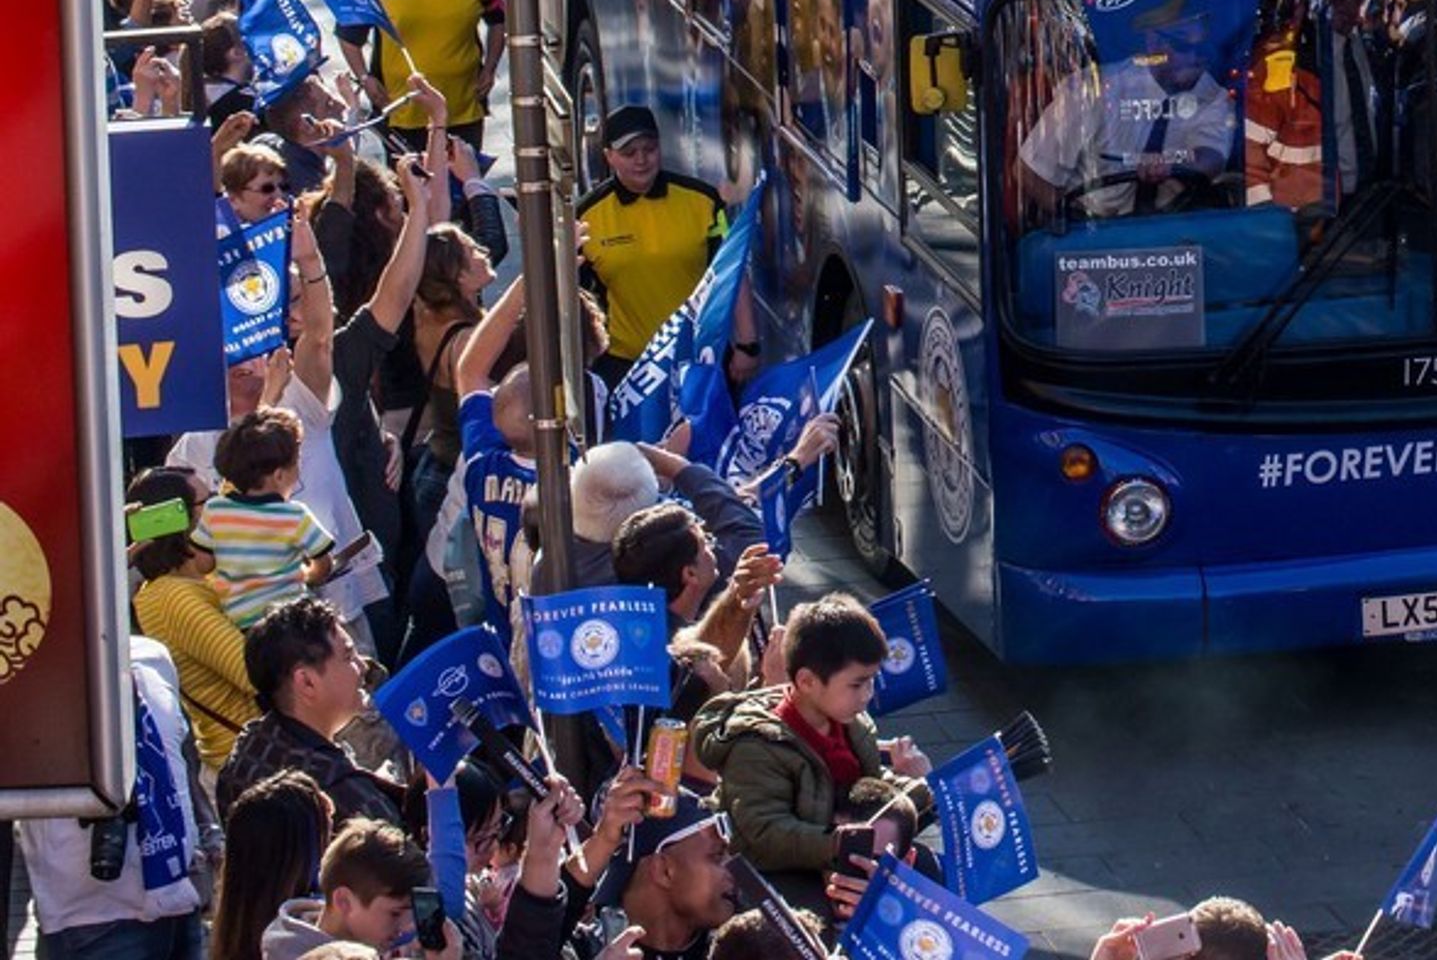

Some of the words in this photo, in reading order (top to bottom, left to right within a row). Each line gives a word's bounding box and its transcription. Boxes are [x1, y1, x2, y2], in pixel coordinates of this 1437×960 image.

[1058, 250, 1198, 272] teambus.co.uk
[1104, 268, 1193, 303] Knight
[591, 600, 657, 615] FEARLESS
[943, 910, 1012, 958] FEARLESS
